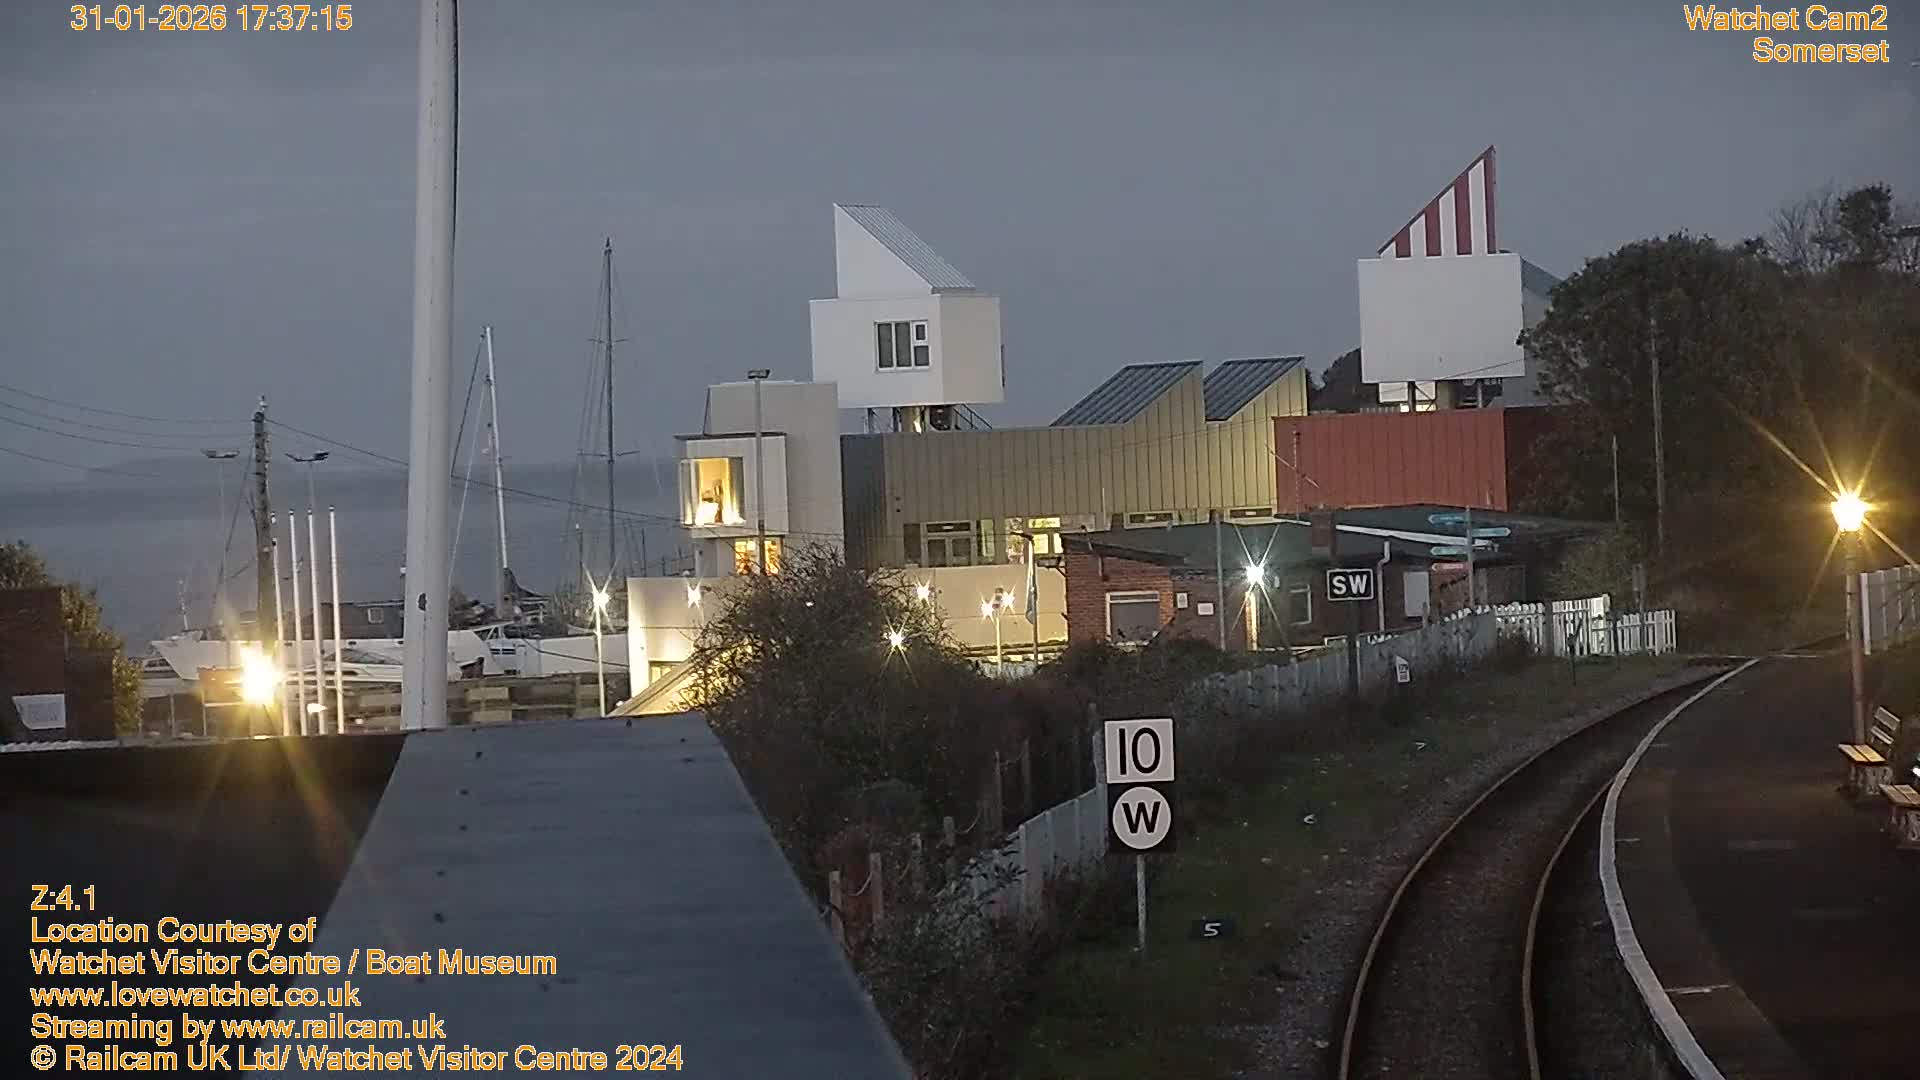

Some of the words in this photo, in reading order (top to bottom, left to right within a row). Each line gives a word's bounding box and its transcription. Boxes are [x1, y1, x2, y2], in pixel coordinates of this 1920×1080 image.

[1332, 575, 1367, 595] SW
[1118, 727, 1161, 774] 10
[1121, 801, 1161, 834] W
[1203, 922, 1221, 937] 5
